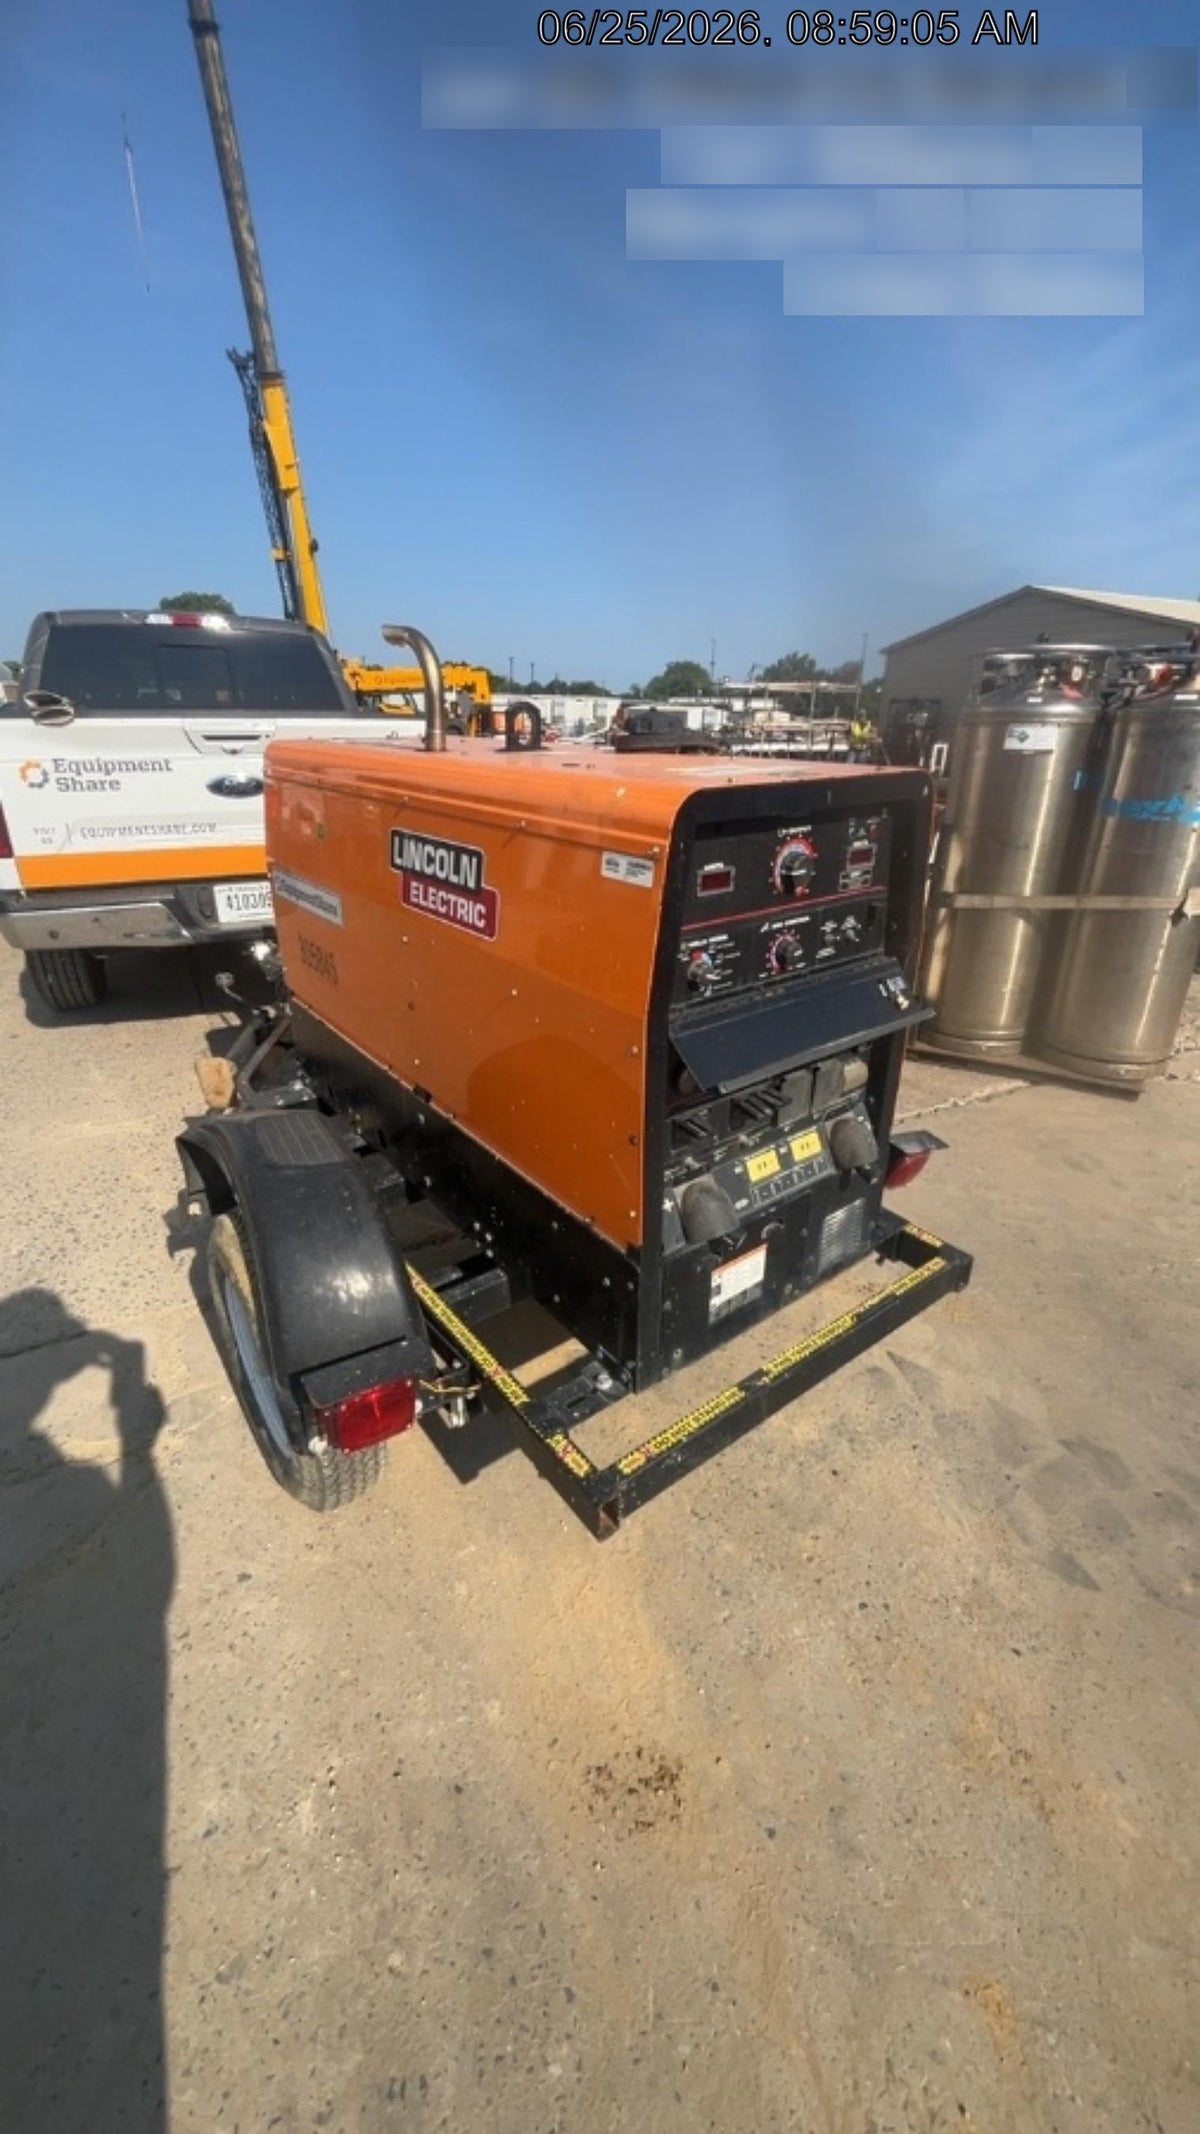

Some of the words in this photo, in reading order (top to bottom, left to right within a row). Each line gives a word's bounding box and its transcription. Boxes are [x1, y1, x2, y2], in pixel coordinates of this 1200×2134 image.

[53, 758, 173, 776] Equipment
[56, 777, 121, 793] Share
[393, 836, 477, 890] LINCOLN
[409, 881, 487, 928] ELECTRIC
